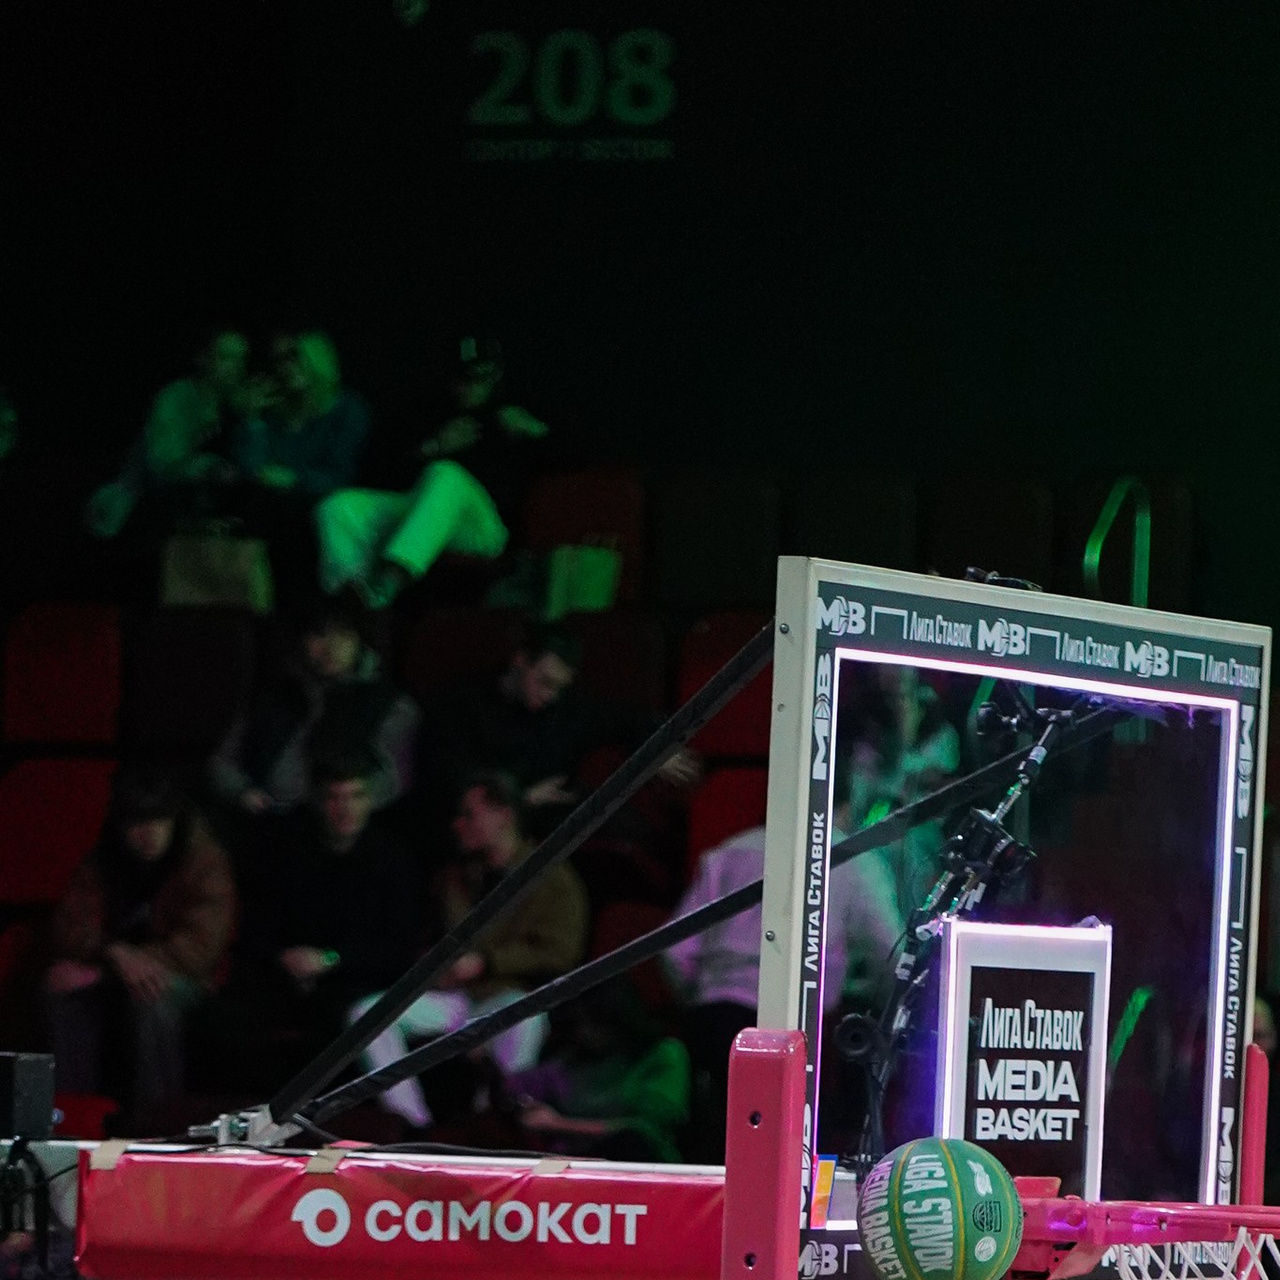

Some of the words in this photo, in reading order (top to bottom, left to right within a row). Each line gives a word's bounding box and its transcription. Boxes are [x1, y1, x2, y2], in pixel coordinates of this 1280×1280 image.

[469, 29, 677, 126] 208
[976, 1058, 1080, 1102] MEDIA
[975, 1109, 1081, 1142] BASKET
[903, 1154, 948, 1195] LIGA
[861, 1210, 907, 1280] BASKET
[903, 1197, 954, 1274] STAVOK
